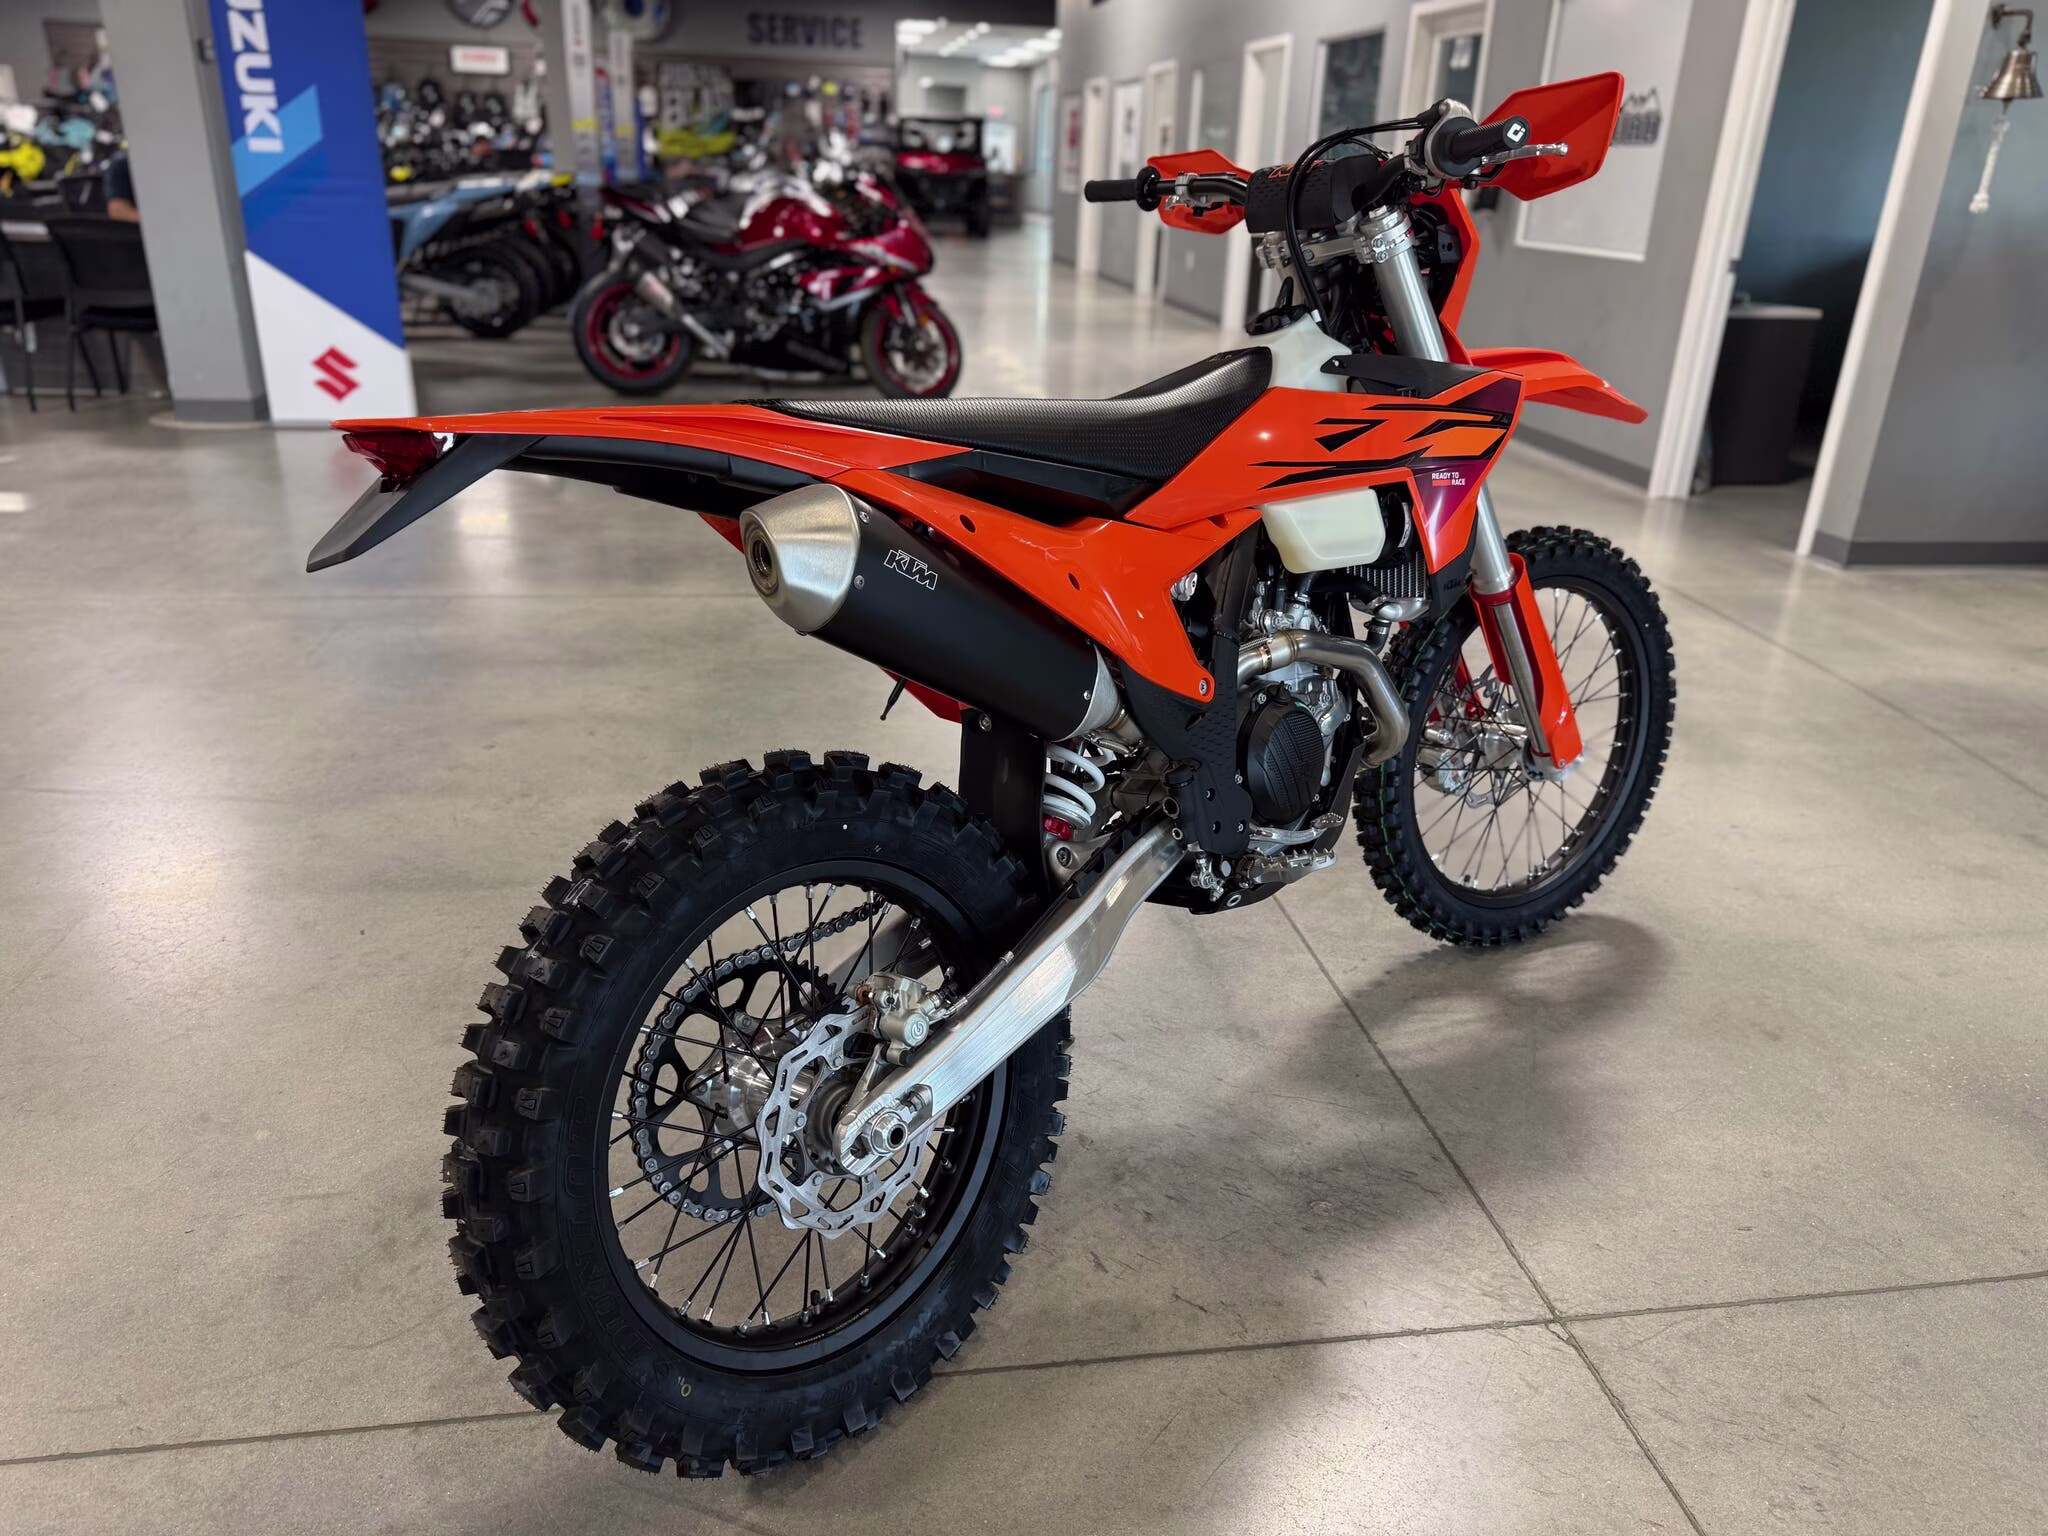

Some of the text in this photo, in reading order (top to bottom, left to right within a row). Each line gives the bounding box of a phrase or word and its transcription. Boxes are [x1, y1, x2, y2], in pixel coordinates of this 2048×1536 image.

[747, 11, 864, 48] SERVICE
[225, 0, 284, 153] ZUKI
[1431, 471, 1460, 480] READY TO
[1451, 478, 1466, 486] RACE
[883, 549, 938, 591] KTM
